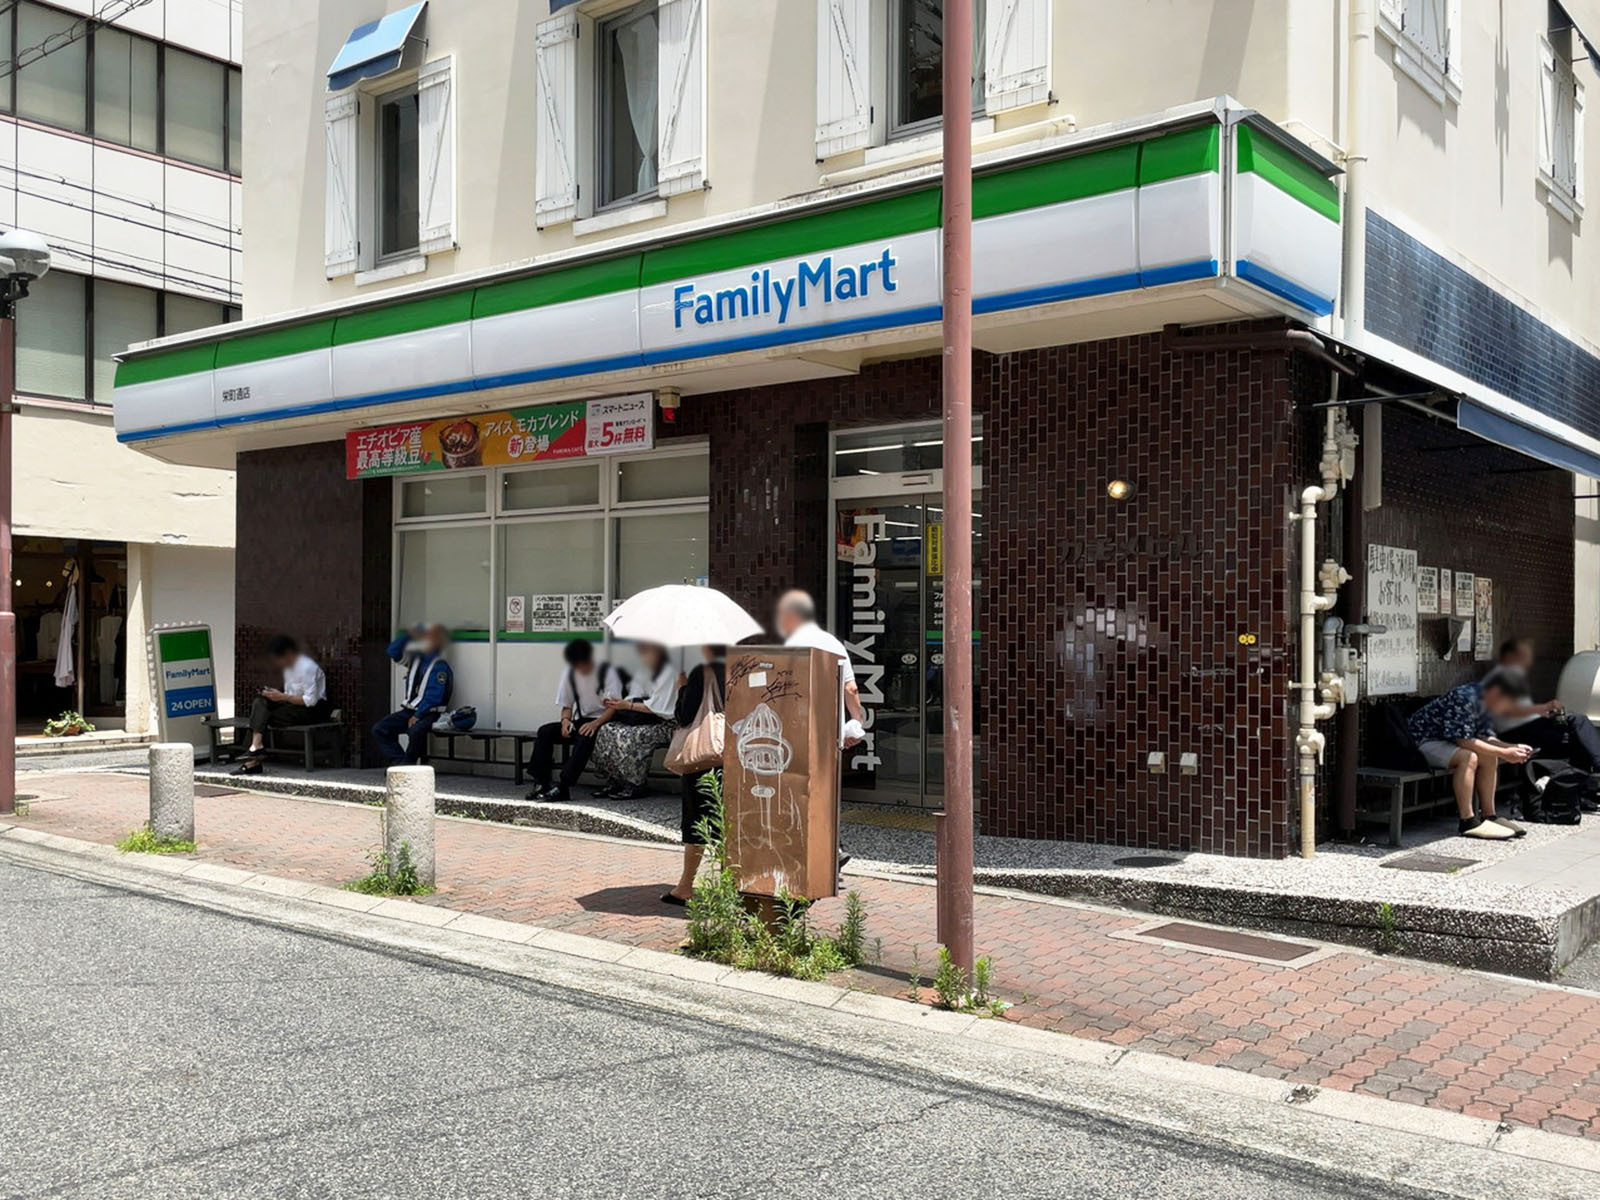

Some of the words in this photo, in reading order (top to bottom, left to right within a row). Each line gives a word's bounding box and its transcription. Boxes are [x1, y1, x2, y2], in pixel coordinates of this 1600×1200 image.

[674, 248, 896, 328] FamilyMart
[602, 400, 645, 414] スマートニュース
[484, 420, 513, 437] アイス
[516, 409, 579, 432] モカブレンド
[356, 427, 421, 449] エチオピア産
[509, 434, 549, 457] 新登場
[356, 447, 420, 469] 最高等級豆
[165, 668, 210, 679] FamilyMart
[171, 701, 183, 711] 24
[184, 698, 212, 710] OPEN
